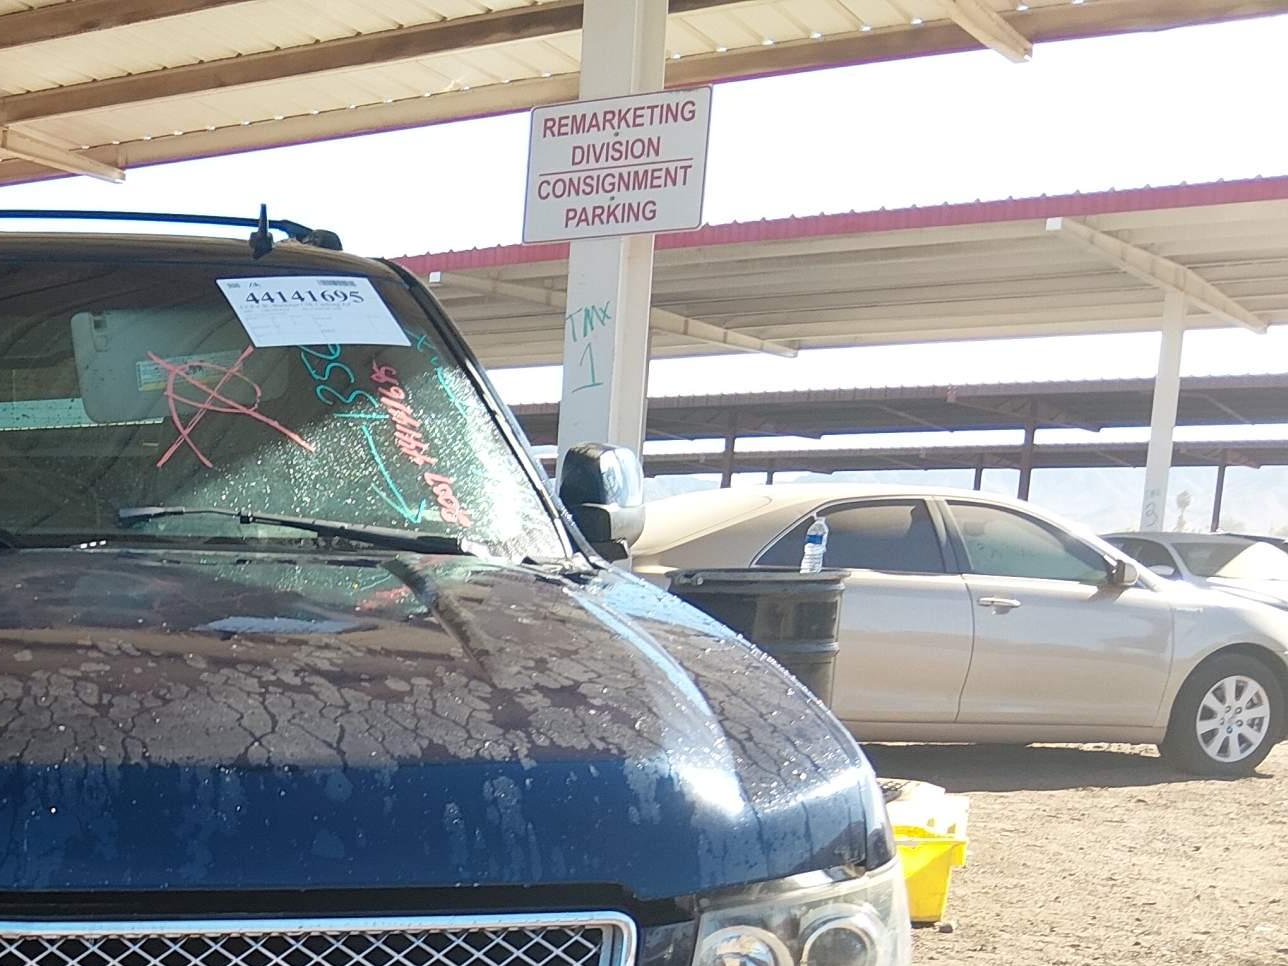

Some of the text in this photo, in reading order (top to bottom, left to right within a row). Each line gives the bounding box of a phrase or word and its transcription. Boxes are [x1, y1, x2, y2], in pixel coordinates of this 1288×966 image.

[543, 100, 696, 138] REMARKETING
[571, 136, 661, 166] DIVISION
[538, 164, 693, 200] CONSIGNMENT
[565, 200, 657, 228] PARKING
[246, 289, 365, 304] 44141695
